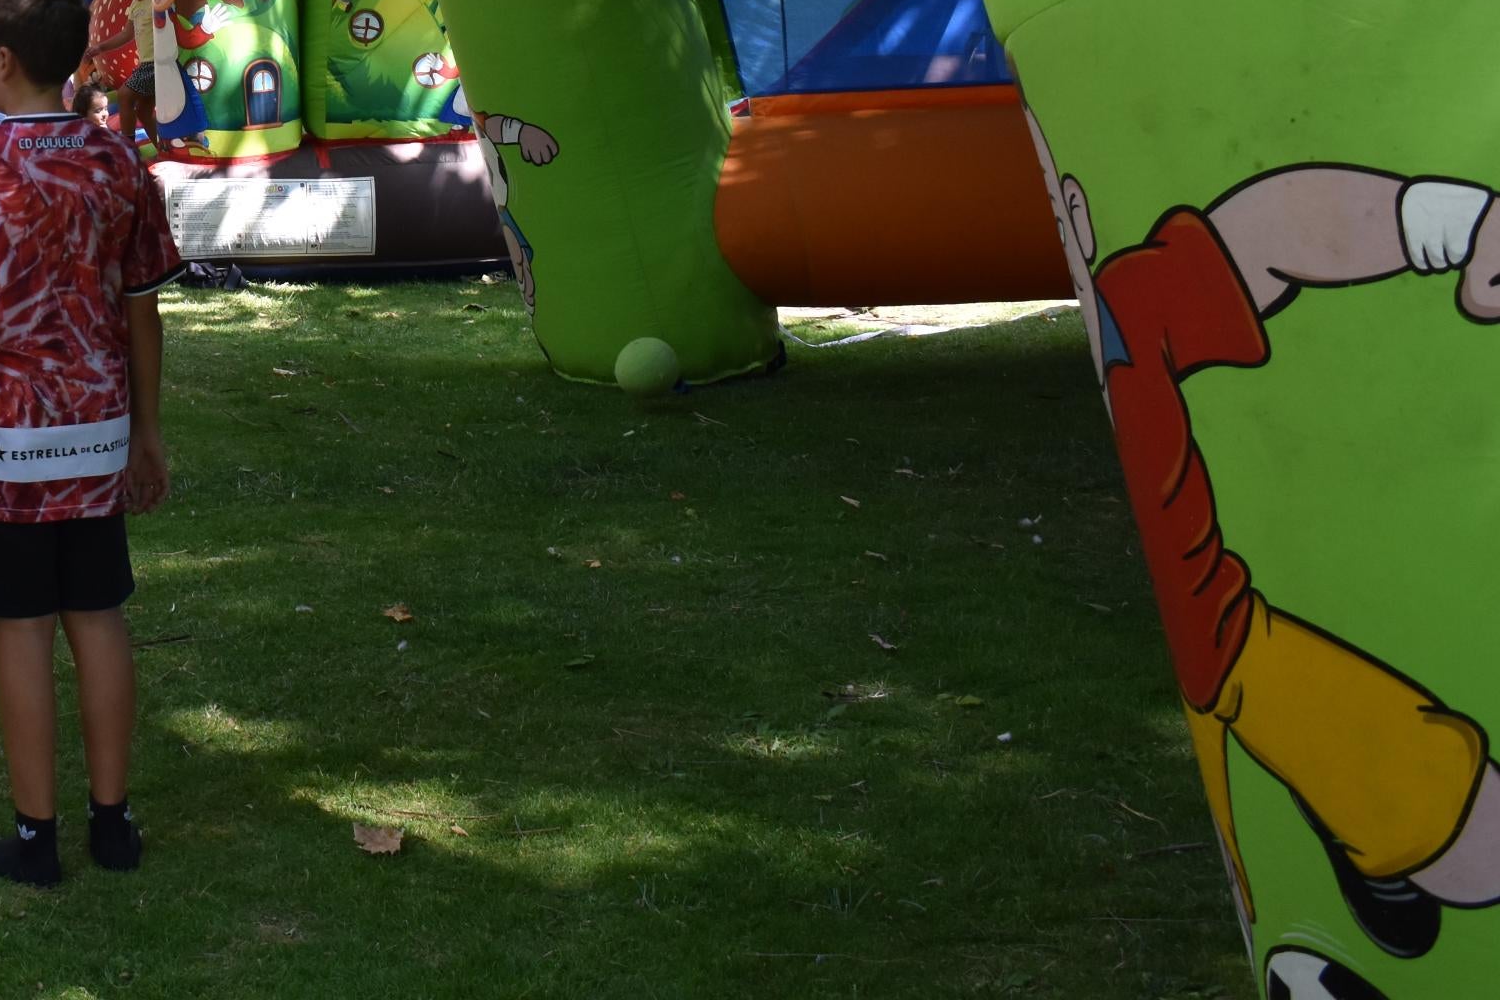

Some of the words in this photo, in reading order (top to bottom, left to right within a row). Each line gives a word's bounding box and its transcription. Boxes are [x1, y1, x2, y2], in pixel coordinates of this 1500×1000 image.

[18, 137, 33, 149] CD
[35, 136, 85, 149] GUIJUELO
[11, 447, 78, 461] ESTRELLA
